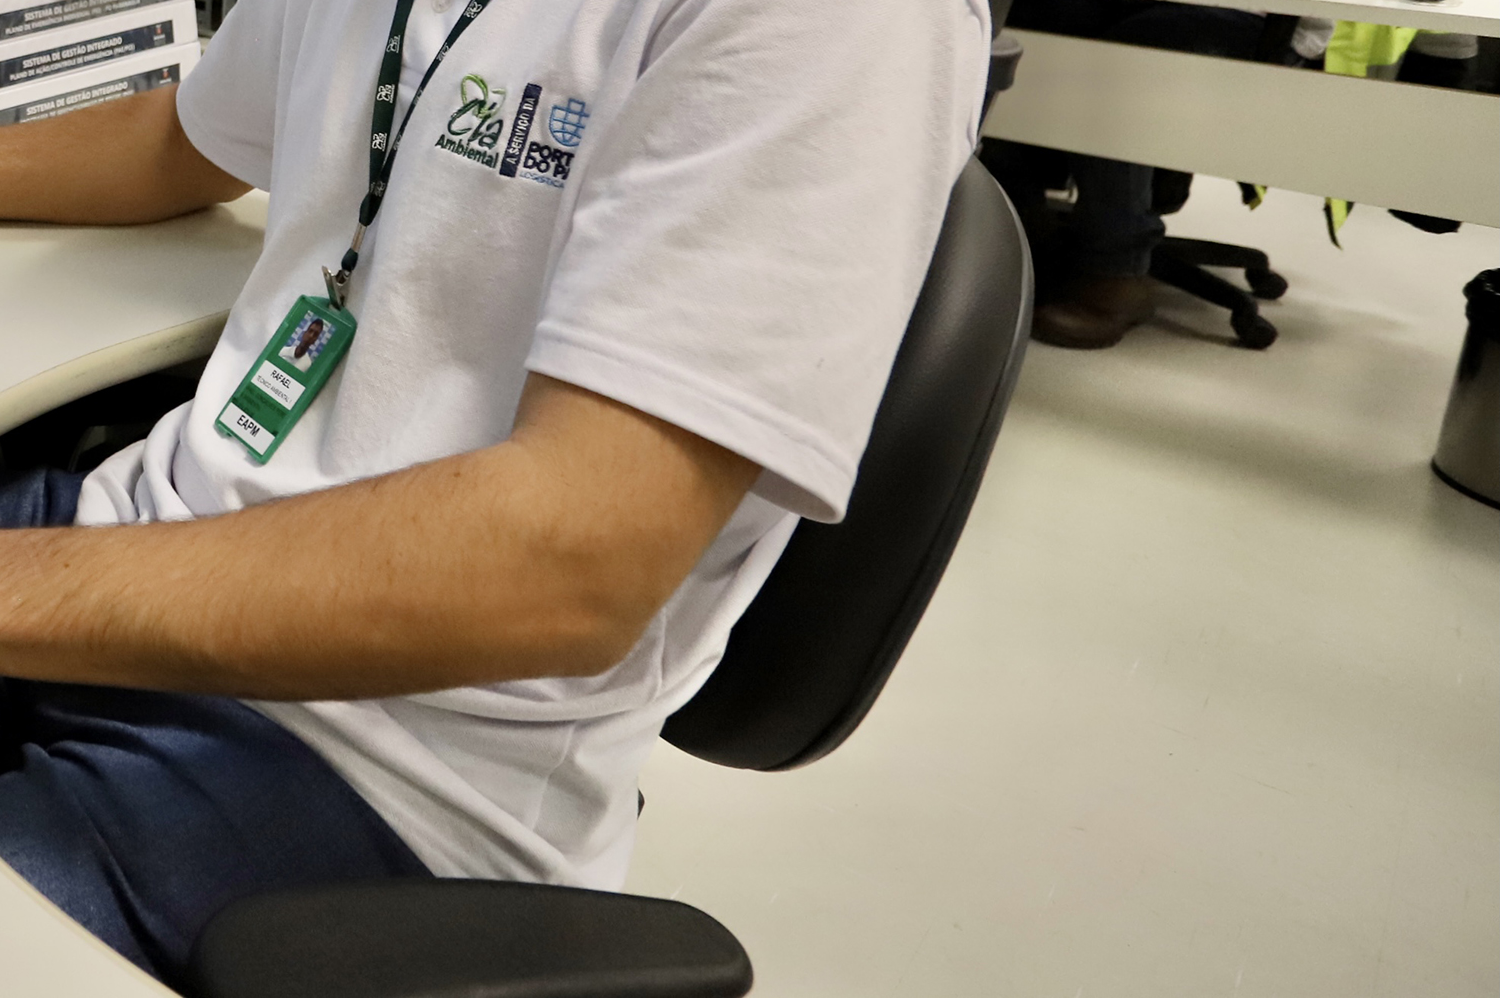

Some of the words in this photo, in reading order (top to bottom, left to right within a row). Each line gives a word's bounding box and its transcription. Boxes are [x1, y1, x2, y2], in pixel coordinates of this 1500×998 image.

[24, 7, 52, 22] SISTEMA
[54, 5, 62, 15] DE
[63, 0, 88, 13] GESTÃO
[5, 26, 23, 35] PLANO
[23, 54, 50, 69] SISTEMA
[52, 52, 61, 62] DE
[61, 44, 86, 60] GESTÃO
[87, 37, 123, 53] INTEGRADO
[10, 72, 27, 81] PLANO
[26, 102, 55, 116] SISTEMA
[57, 100, 65, 109] DE
[66, 92, 91, 106] GESTÃO
[92, 81, 128, 98] INTEGRADO
[447, 98, 503, 150] Cia
[506, 156, 517, 165] A
[522, 97, 535, 111] DA
[435, 133, 499, 169] Ambiental
[523, 156, 550, 173] DO
[270, 369, 292, 389] RAFAEL
[237, 414, 260, 438] EAPM
